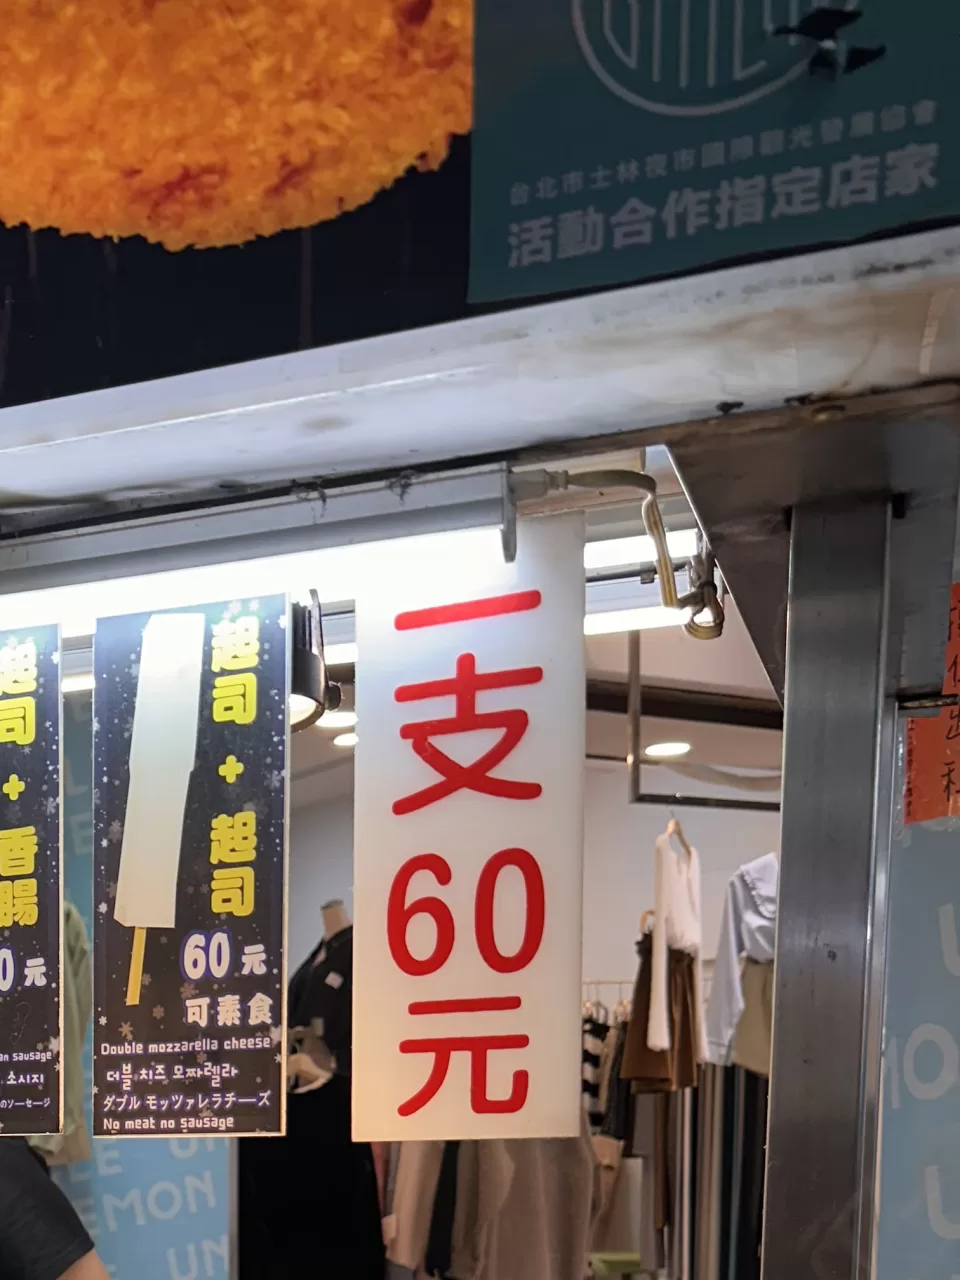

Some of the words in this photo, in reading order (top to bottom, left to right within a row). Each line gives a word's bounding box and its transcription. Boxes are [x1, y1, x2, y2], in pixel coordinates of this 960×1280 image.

[506, 141, 940, 269] 活動合作指定店家
[210, 614, 260, 726] 起司
[209, 810, 257, 918] 起司
[185, 994, 273, 1028] 可素食
[12, 1051, 52, 1063] sausage
[101, 1042, 143, 1055] Double
[149, 1038, 219, 1053] mozzarella
[224, 1036, 271, 1050] cheese
[6, 1070, 44, 1085] 소시지
[106, 1062, 133, 1091] 더블
[139, 1064, 167, 1081] 치즈
[103, 1094, 140, 1112] ダブル
[103, 1118, 120, 1130] No
[125, 1117, 156, 1129] meat
[160, 1118, 175, 1129] no
